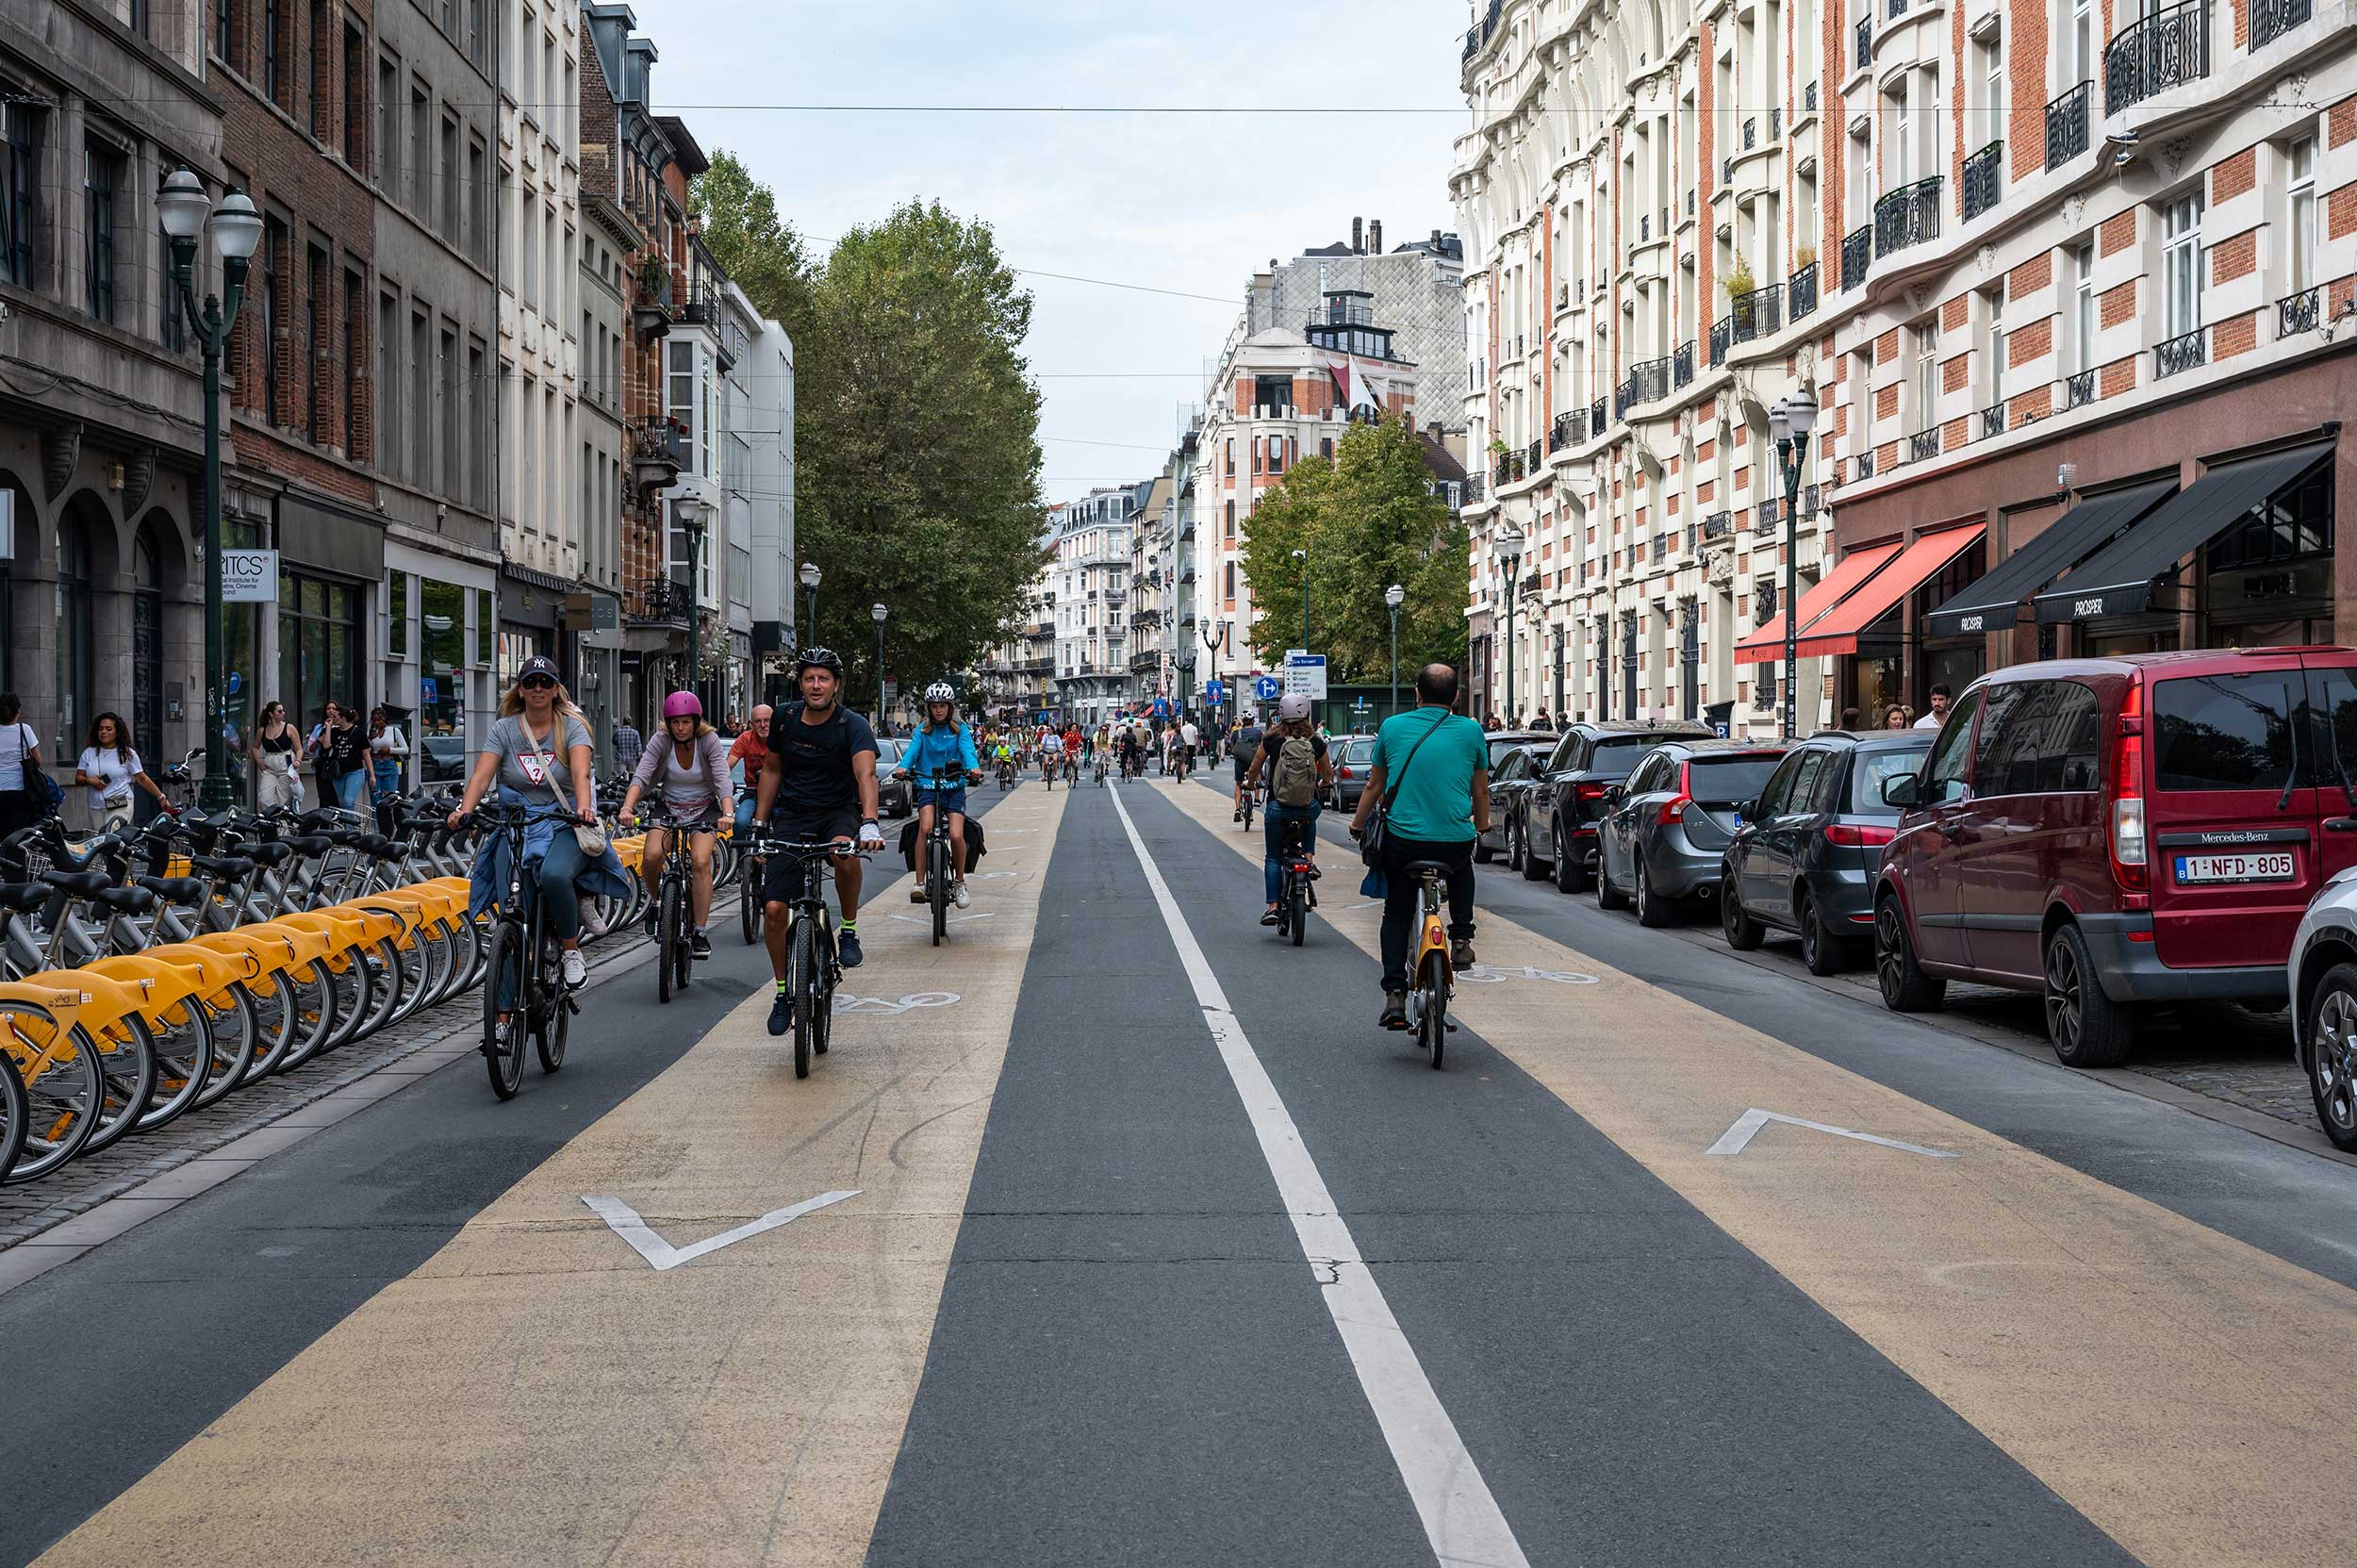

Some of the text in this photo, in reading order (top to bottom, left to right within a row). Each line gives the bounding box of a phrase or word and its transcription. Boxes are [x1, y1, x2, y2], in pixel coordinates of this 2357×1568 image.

[2075, 598, 2102, 617] PROSPER
[592, 608, 613, 619] OS
[1961, 616, 1983, 631] PROSPER
[523, 755, 551, 765] GUES
[2201, 832, 2269, 843] Mercedes-Benz
[2179, 869, 2186, 879] B
